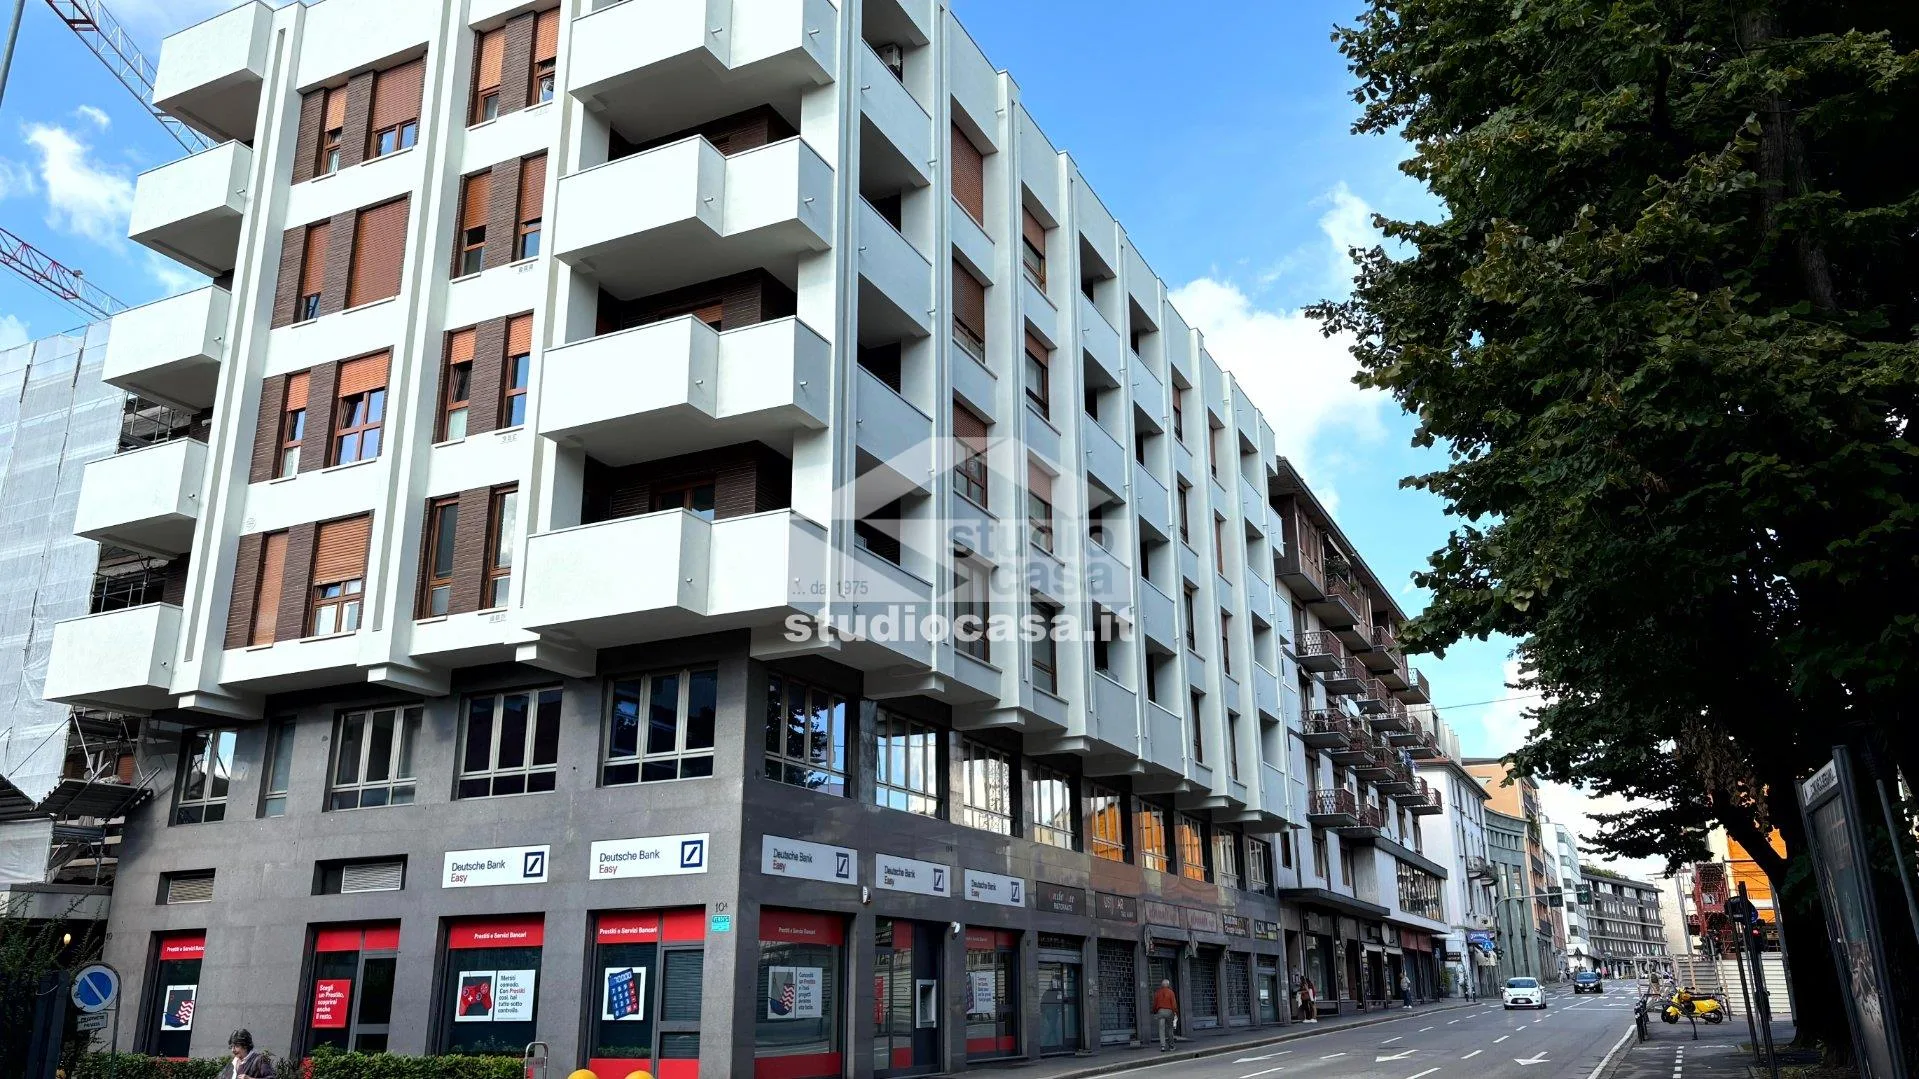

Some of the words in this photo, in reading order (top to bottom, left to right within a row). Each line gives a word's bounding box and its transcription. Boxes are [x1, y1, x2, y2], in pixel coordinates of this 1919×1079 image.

[600, 851, 638, 862] Deutsche
[639, 849, 660, 859] Bank
[773, 848, 798, 861] Deutsche
[799, 852, 812, 863] Bank
[451, 861, 486, 871] Deutsche
[487, 860, 506, 870] Bank
[599, 864, 618, 875] Easy
[772, 860, 786, 872] Easy
[450, 873, 468, 883] Easy
[639, 926, 657, 934] Bancari
